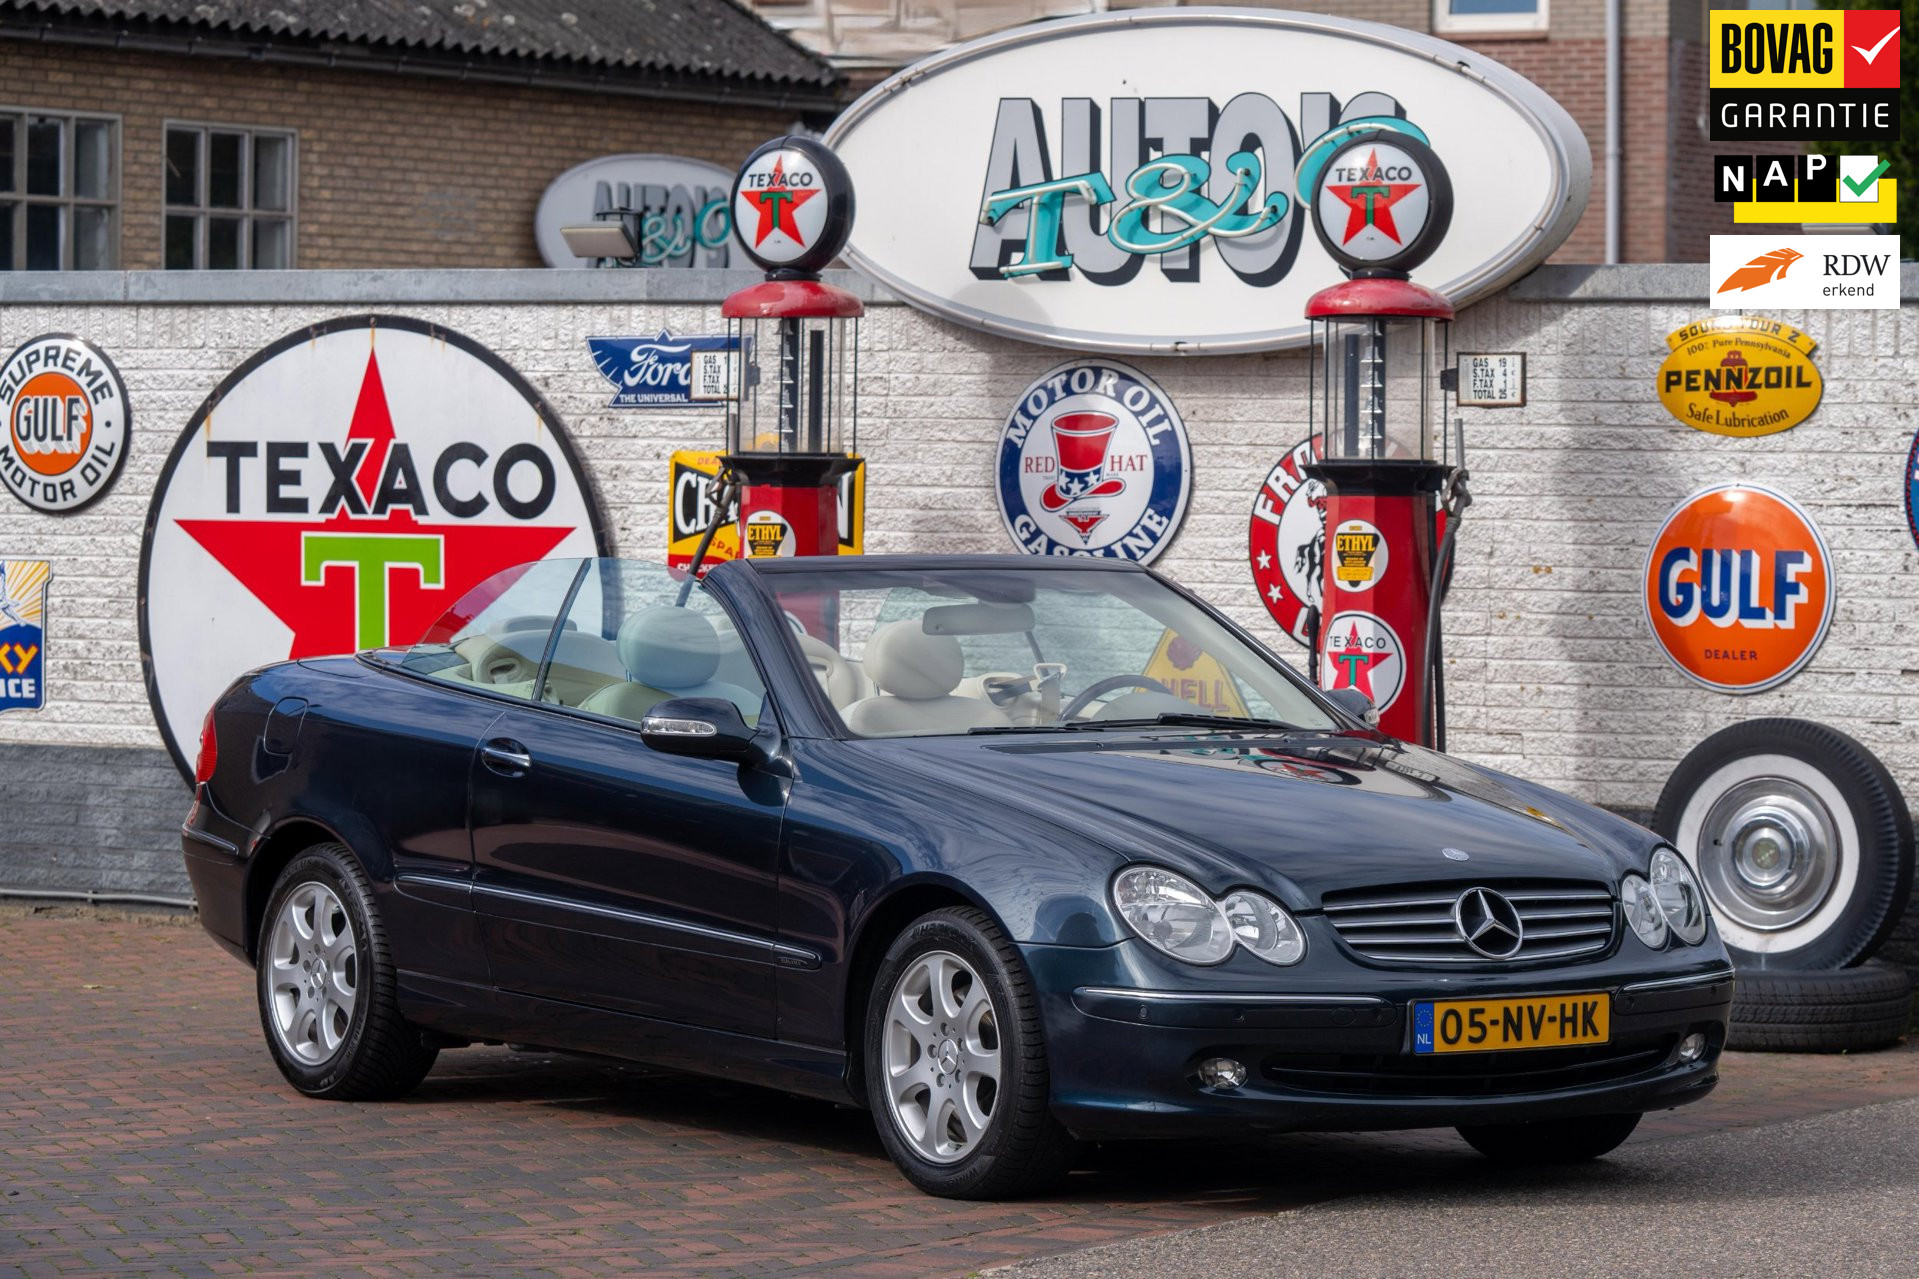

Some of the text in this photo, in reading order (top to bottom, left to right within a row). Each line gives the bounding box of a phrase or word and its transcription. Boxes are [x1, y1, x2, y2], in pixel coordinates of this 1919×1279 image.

[748, 172, 813, 188] TEXACO
[1335, 166, 1412, 182] TEXACO
[1712, 339, 1733, 348] Pure
[1735, 337, 1791, 359] Pennsylvania
[703, 354, 717, 364] GAS
[1473, 357, 1507, 368] GAS 19
[0, 345, 114, 406] SUPREME
[703, 365, 721, 375] S.TAX
[1473, 368, 1507, 378] S.TAX 4
[703, 375, 720, 384] F.TAX
[1473, 379, 1494, 389] F.TAX
[1665, 365, 1813, 393] PENNZOIL
[703, 385, 721, 395] TOTAL
[1473, 389, 1507, 400] TOTAL 25
[619, 394, 689, 403] THE UNIVERSAL
[1006, 368, 1172, 449] MOTOR OIL
[1686, 402, 1789, 428] Safe Lubrication
[15, 396, 86, 453] GULF
[0, 441, 115, 503] MOTOR OIL
[1024, 455, 1148, 474] RED HAT
[206, 440, 556, 518] TEXACO
[748, 524, 783, 541] ETHYL
[1336, 535, 1376, 552] ETHYL
[1659, 546, 1812, 630] GULF
[1329, 634, 1387, 650] TEXACO
[1704, 648, 1758, 662] DEALER
[1440, 1000, 1601, 1046] 05-NV-HK
[1416, 1033, 1432, 1045] NL
